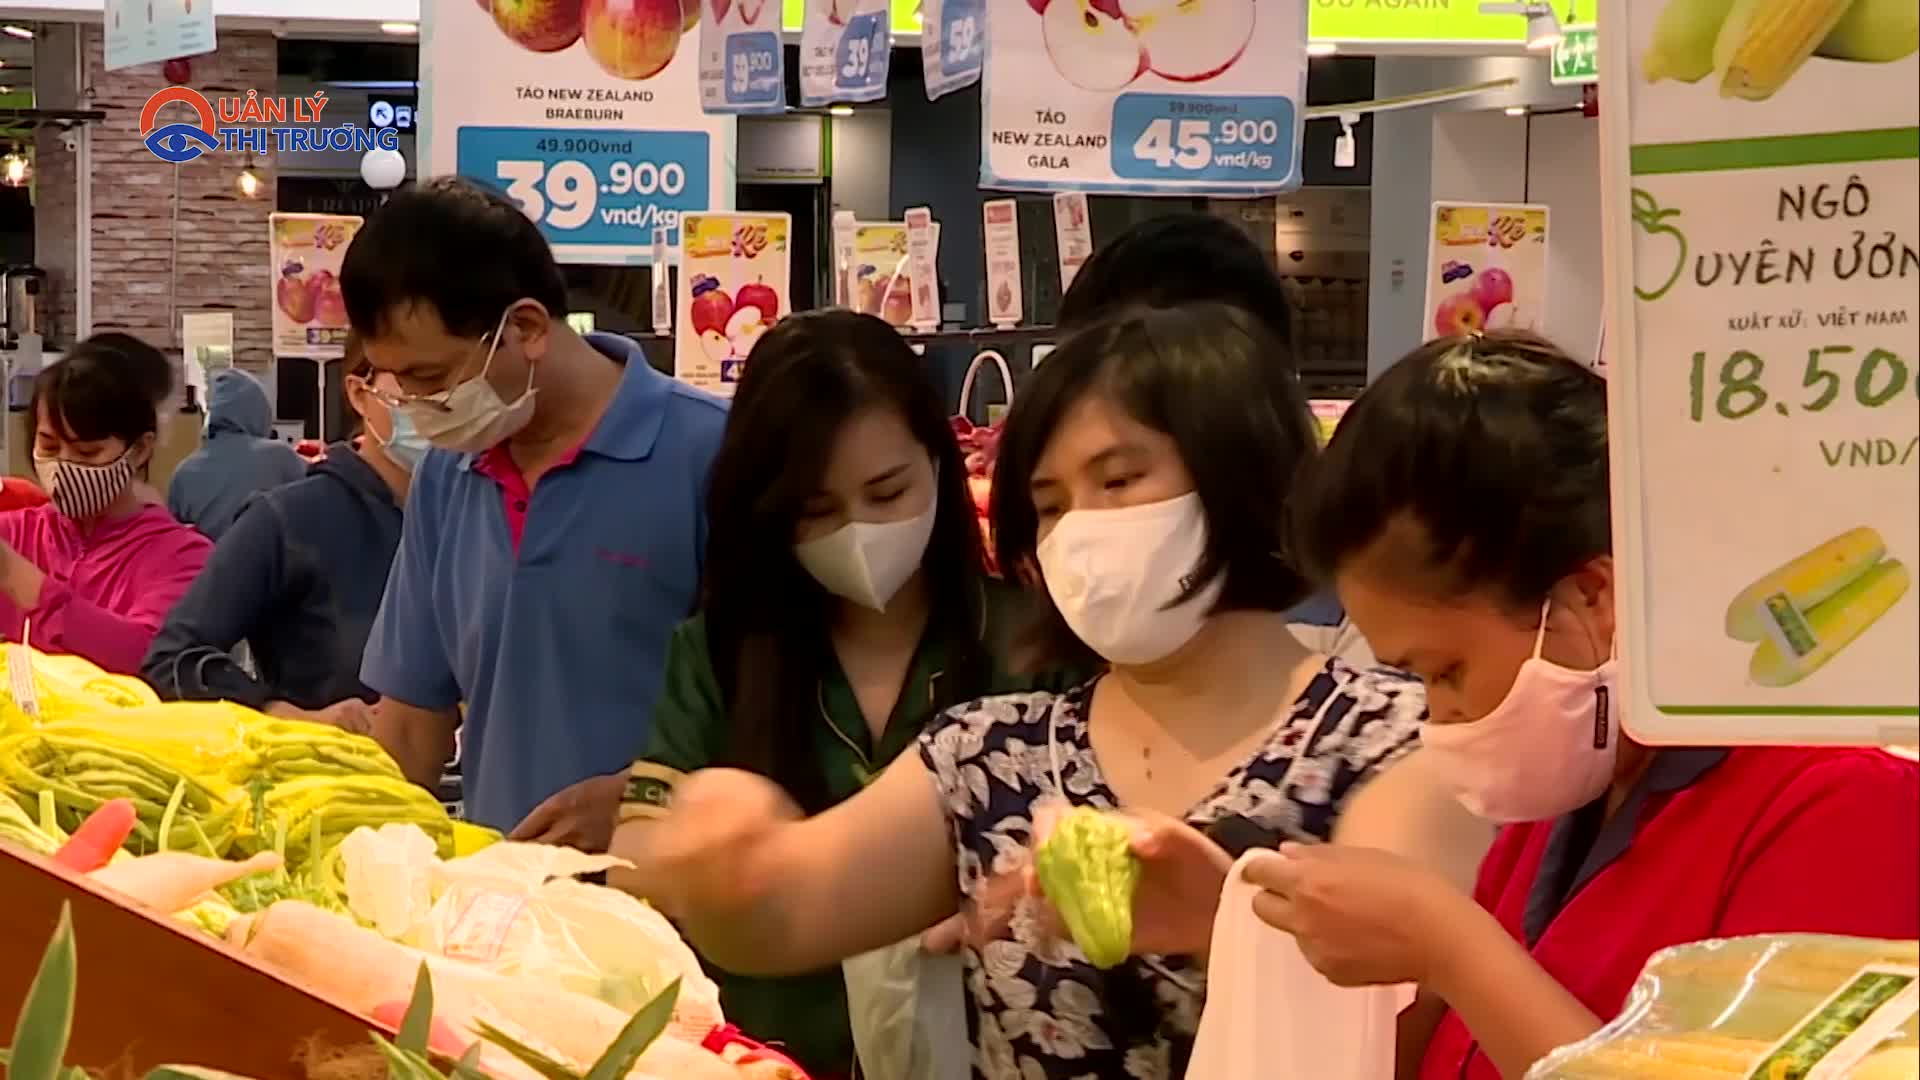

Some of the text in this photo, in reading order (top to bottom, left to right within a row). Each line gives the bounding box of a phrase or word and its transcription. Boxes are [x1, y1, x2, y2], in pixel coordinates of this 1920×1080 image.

[515, 86, 654, 102] TÁO NEW ZEALAND
[545, 108, 623, 121] BRAEBURN
[1035, 107, 1066, 125] TÁO
[536, 138, 633, 155] 49.900vnd
[992, 131, 1107, 149] NEW ZEALAND
[1027, 155, 1070, 169] GALA
[1214, 151, 1273, 170] vnd/kg
[1777, 174, 1870, 222] NGÔ
[1695, 239, 1815, 287] UYÊN
[1864, 309, 1908, 326] NAM
[1690, 345, 1918, 422] 18.50
